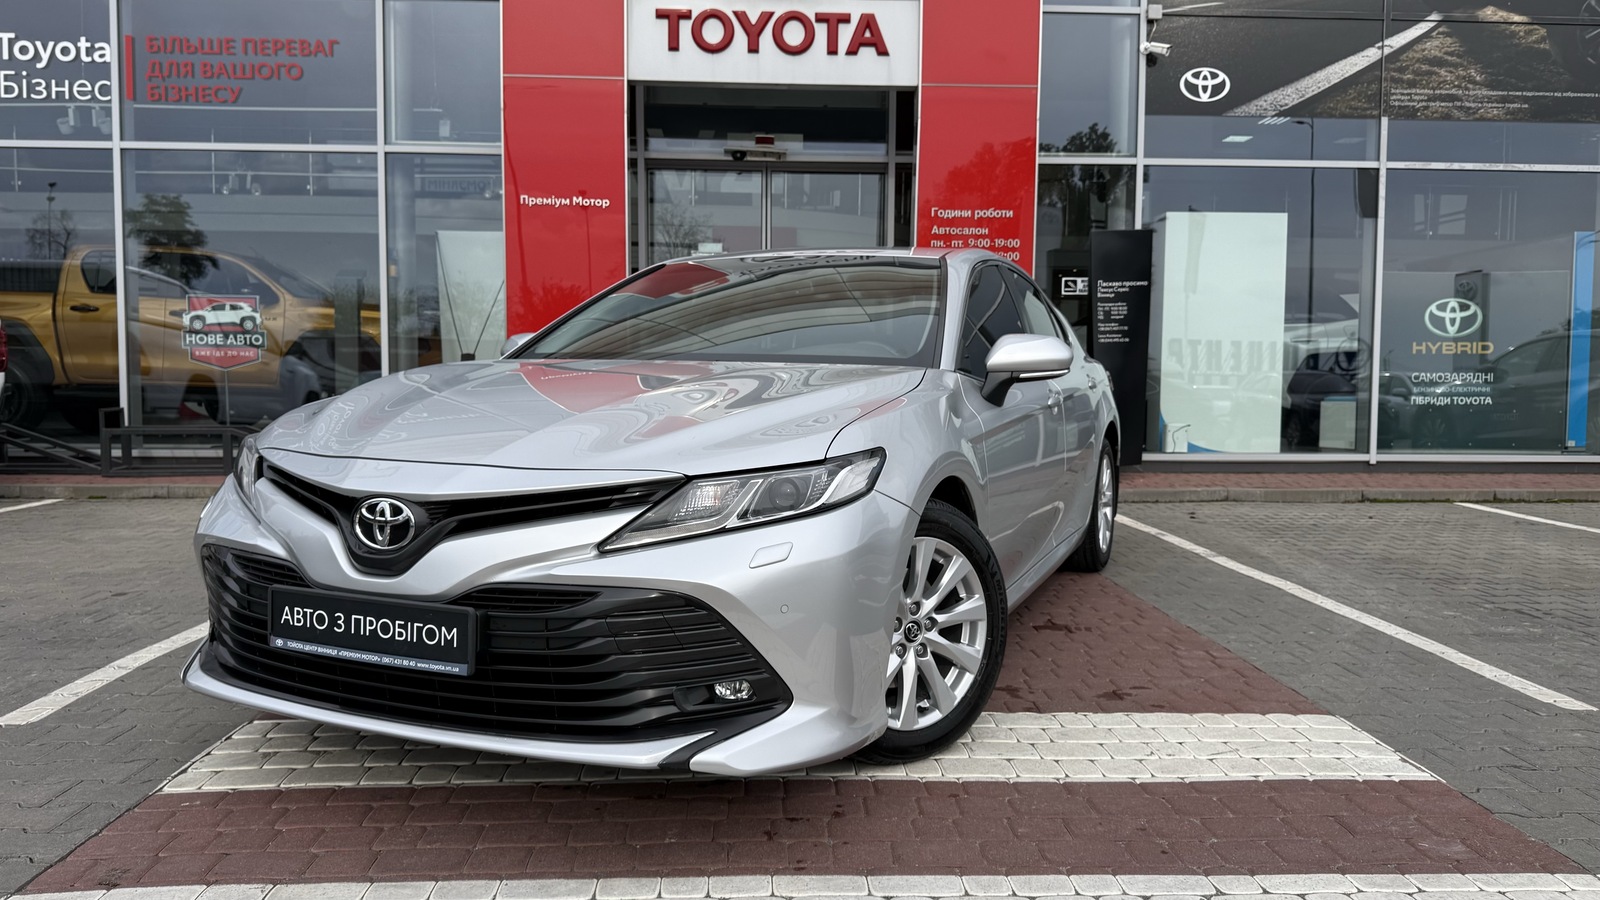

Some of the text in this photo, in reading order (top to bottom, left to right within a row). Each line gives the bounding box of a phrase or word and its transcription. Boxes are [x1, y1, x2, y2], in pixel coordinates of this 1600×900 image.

[655, 8, 890, 56] TOYOTA
[0, 32, 111, 68] Toyota
[145, 36, 340, 57] БІЛЬШЕ ПЕРЕВАГ
[145, 60, 304, 80] ДЛЯ ВАШОГО
[0, 70, 111, 99] Бізнес
[146, 83, 242, 103] БІЗНЕСУ
[520, 194, 610, 208] Преміум Мотор
[931, 207, 1014, 220] Години роботи
[931, 225, 989, 235] Автосалон
[185, 334, 263, 345] НОВЕ АВТО
[1411, 342, 1494, 354] HYBRID
[1411, 372, 1494, 384] САМОЗАРЯДНІ
[1410, 396, 1493, 406] ГІБРИДИ TOYOTA
[281, 605, 458, 648] АВТО З ПРОБІГОМ
[287, 641, 304, 650] ТОЙОТА
[304, 644, 318, 652] ЦЕНТР
[317, 646, 338, 656] ВІННИЦЯ
